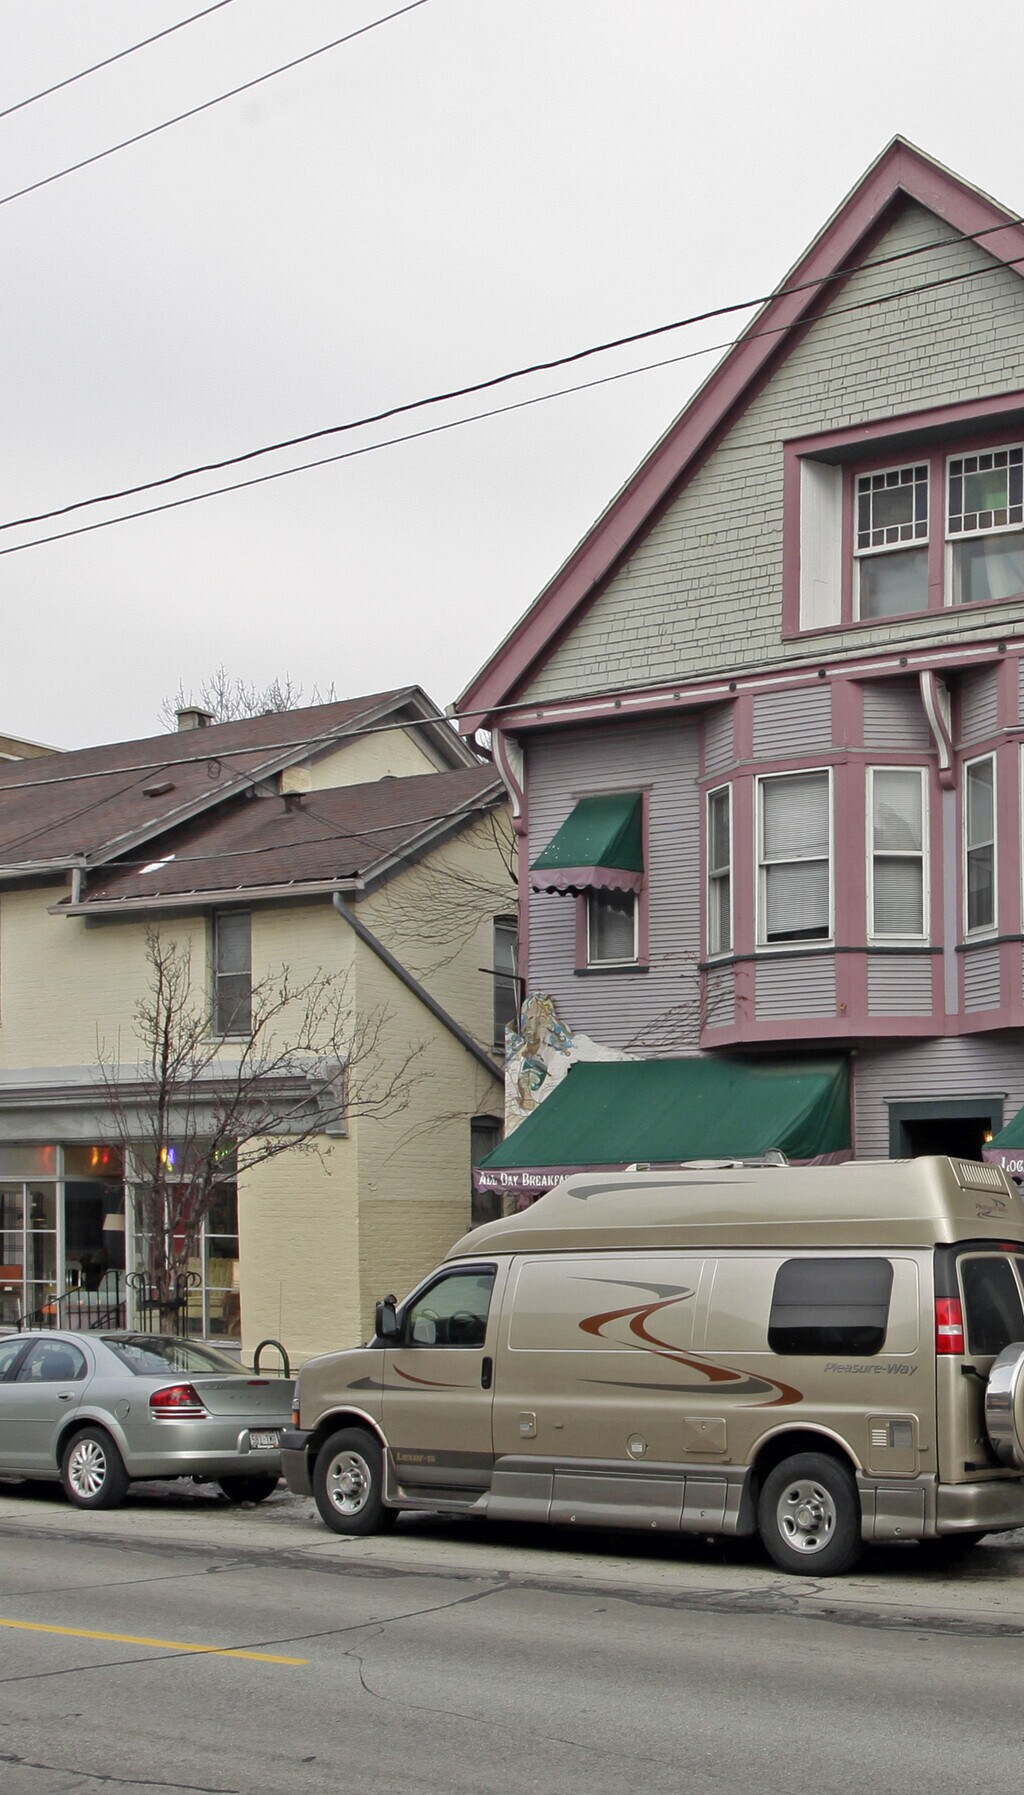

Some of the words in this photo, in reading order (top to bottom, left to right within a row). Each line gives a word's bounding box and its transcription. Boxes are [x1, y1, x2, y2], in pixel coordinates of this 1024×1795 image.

[478, 1172, 498, 1186] ALL
[500, 1172, 519, 1186] DAY
[824, 1362, 918, 1376] Pleasure-Way
